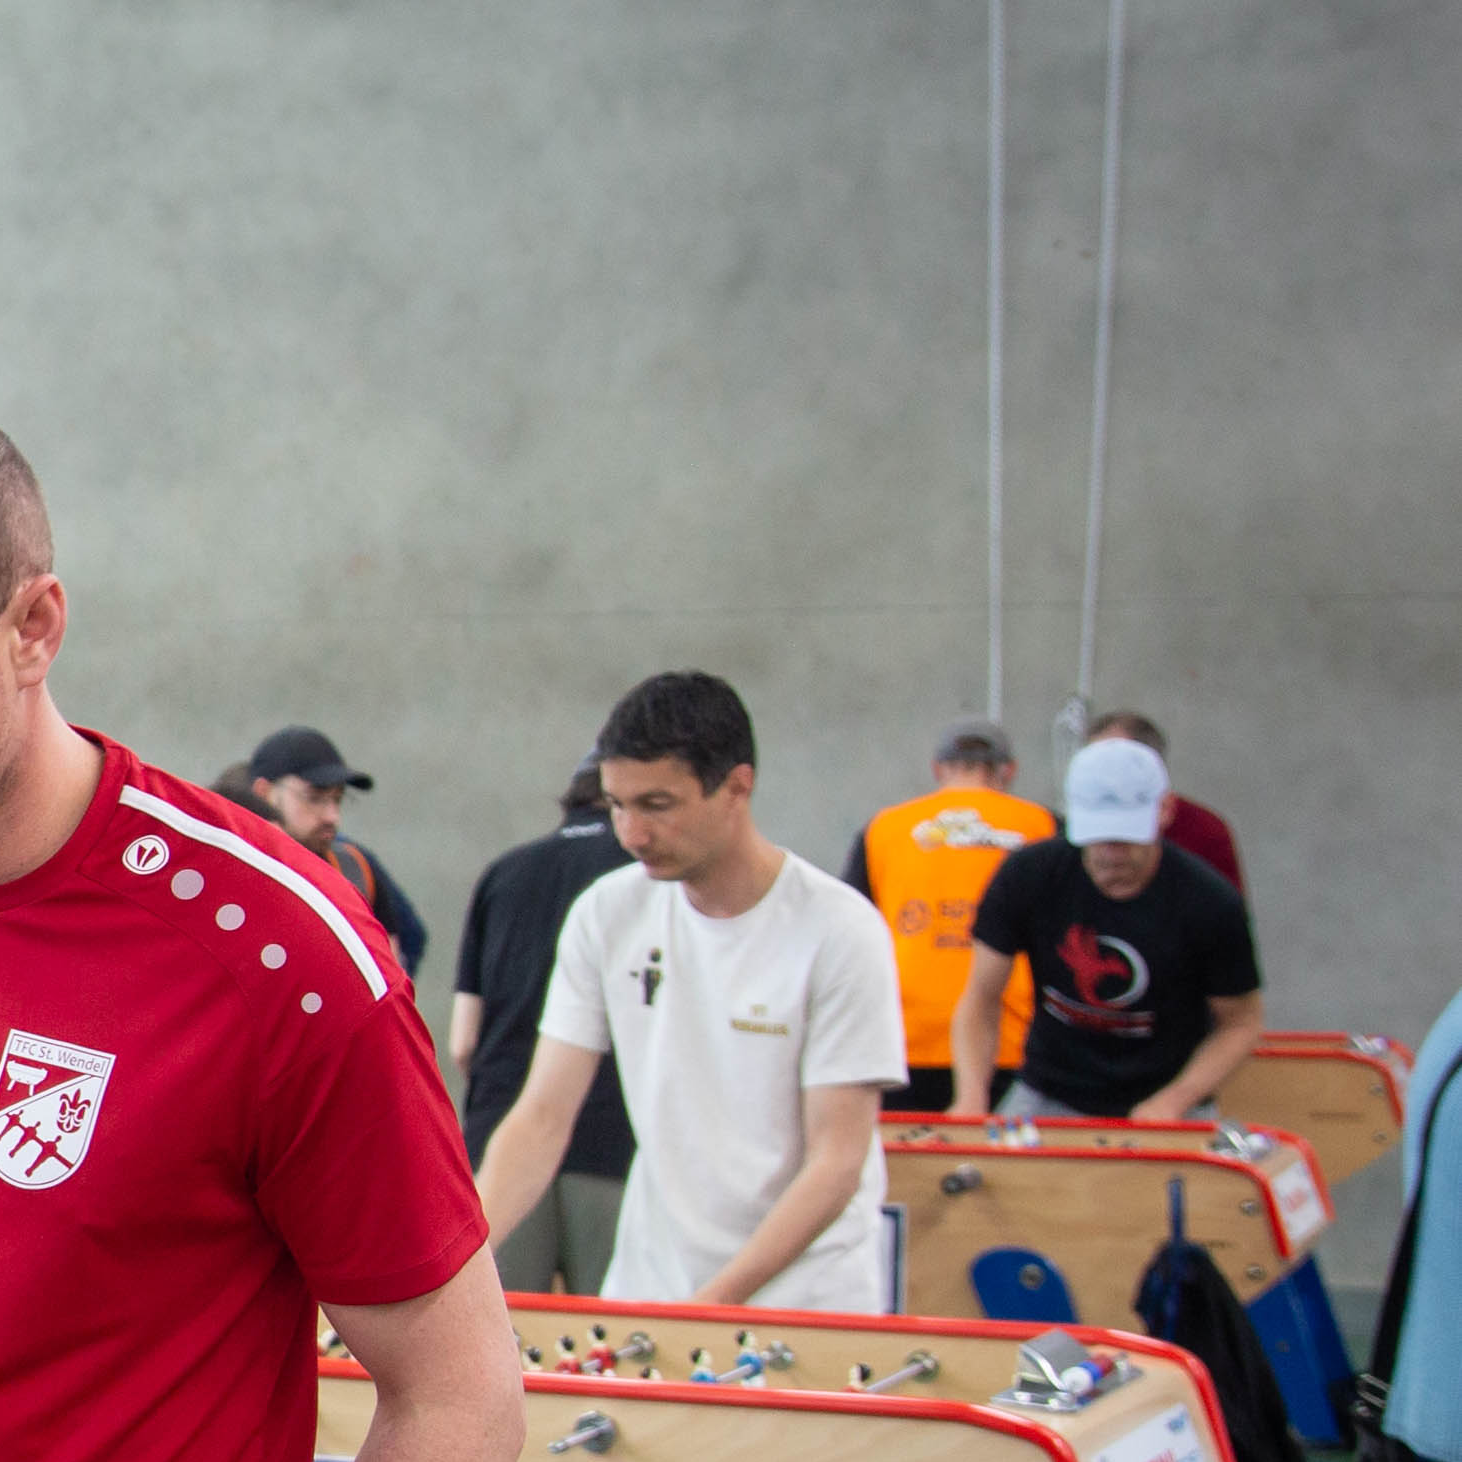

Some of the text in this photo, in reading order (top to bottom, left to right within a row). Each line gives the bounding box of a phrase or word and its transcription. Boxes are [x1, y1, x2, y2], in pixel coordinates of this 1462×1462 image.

[14, 1039, 106, 1074] TFC St. Wendel
